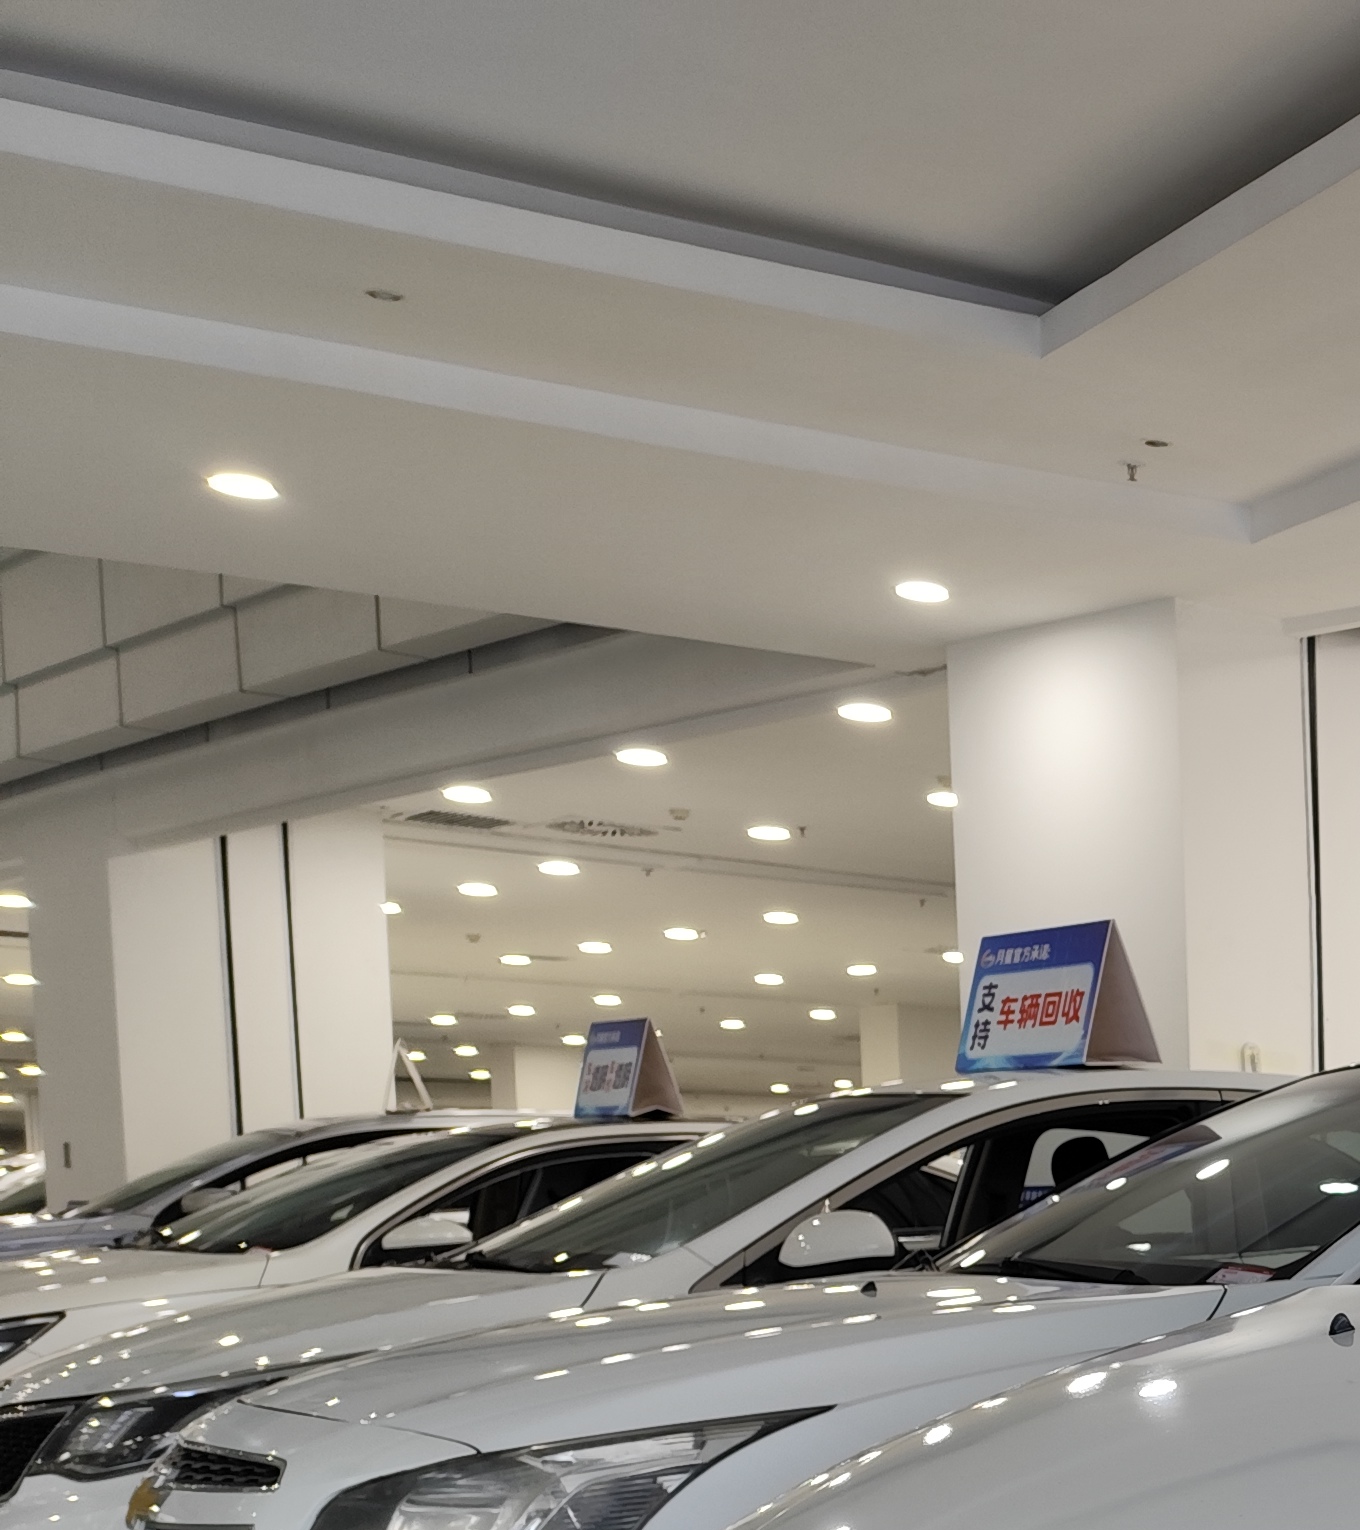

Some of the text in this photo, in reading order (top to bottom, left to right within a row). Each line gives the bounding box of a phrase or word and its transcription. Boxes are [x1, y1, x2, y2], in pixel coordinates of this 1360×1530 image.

[969, 982, 1085, 1051] 支持 车辆回收
